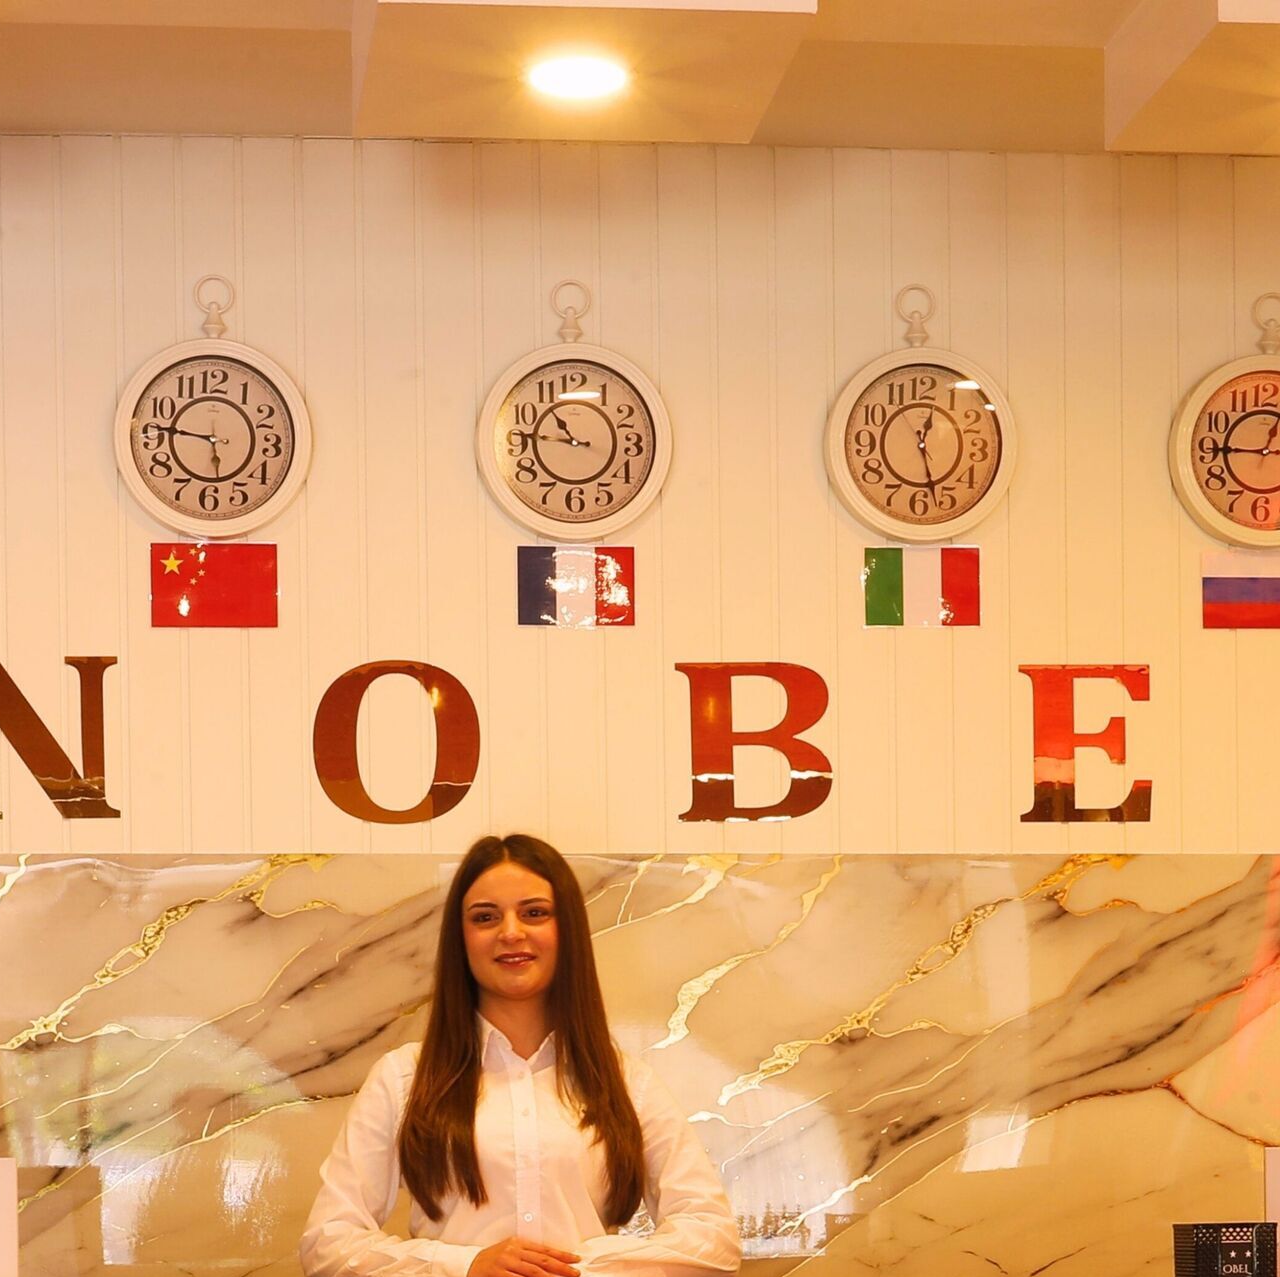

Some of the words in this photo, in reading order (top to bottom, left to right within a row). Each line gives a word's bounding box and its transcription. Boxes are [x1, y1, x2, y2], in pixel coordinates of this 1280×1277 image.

[176, 374, 195, 399] 11
[199, 368, 229, 395] 12
[239, 381, 249, 405] 1
[537, 379, 555, 404] 11
[559, 372, 588, 397] 12
[887, 381, 905, 406] 11
[909, 375, 937, 401] 12
[599, 382, 608, 407] 1
[947, 387, 956, 411] 1
[1230, 388, 1247, 413] 11
[1252, 382, 1279, 408] 12
[152, 395, 176, 420] 10
[256, 404, 275, 430] 2
[513, 402, 538, 426] 10
[616, 404, 634, 429] 2
[863, 402, 887, 427] 10
[963, 409, 981, 434] 2
[1207, 410, 1230, 434] 10
[142, 422, 165, 450] 9
[262, 433, 282, 458] 3
[506, 429, 529, 457] 9
[624, 432, 644, 457] 3
[854, 429, 877, 458] 9
[969, 438, 989, 463] 3
[1198, 436, 1219, 464] 9
[149, 452, 172, 478] 8
[247, 460, 271, 485] 4
[515, 457, 538, 483] 8
[611, 458, 635, 484] 4
[861, 458, 884, 484] 8
[955, 463, 979, 489] 4
[1205, 464, 1227, 491] 8
[173, 477, 192, 502] 7
[198, 484, 220, 512] 6
[229, 482, 249, 507] 5
[538, 481, 557, 505] 7
[564, 487, 586, 513] 6
[594, 482, 614, 507] 5
[884, 483, 903, 507] 7
[938, 486, 957, 511] 5
[1226, 489, 1244, 513] 7
[909, 489, 929, 517] 6
[1250, 495, 1270, 522] 6
